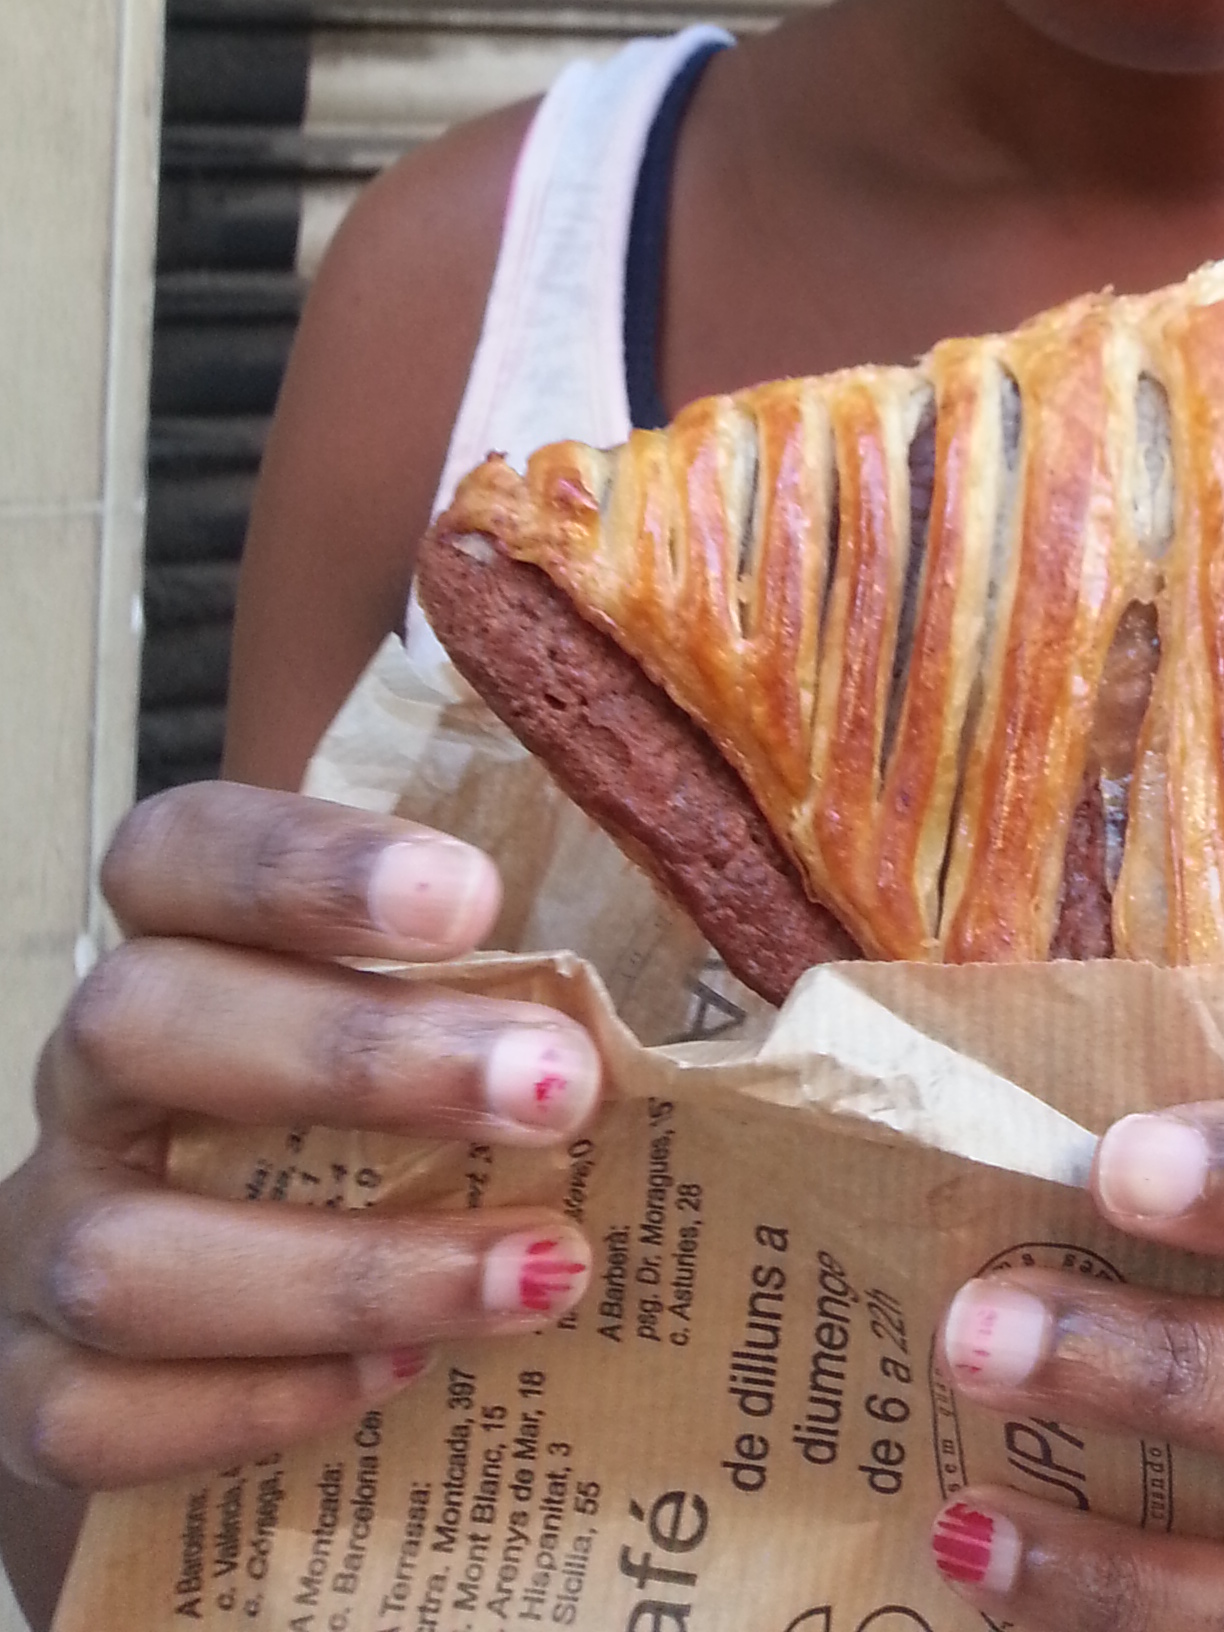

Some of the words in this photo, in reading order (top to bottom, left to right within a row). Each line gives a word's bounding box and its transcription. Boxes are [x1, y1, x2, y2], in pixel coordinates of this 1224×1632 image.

[640, 1130, 675, 1246] Moragues,
[675, 1184, 702, 1212] 28
[754, 1224, 788, 1252] a
[636, 1255, 662, 1285] Dr.
[667, 1221, 704, 1320] Asturies,
[597, 1325, 623, 1342] A
[636, 1294, 663, 1341] psg.
[669, 1328, 689, 1346] c.
[728, 1265, 786, 1417] dilluns
[864, 1288, 908, 1355] 22h
[517, 1370, 547, 1398] 18
[792, 1249, 859, 1465] diumenge
[879, 1357, 912, 1384] a
[448, 1367, 476, 1410] 397
[865, 1395, 909, 1423] 6
[480, 1405, 508, 1432] 15
[511, 1410, 547, 1460] Mar,
[431, 1418, 475, 1553] Montcada,
[470, 1443, 507, 1524] Blanc,
[508, 1468, 535, 1502] de
[720, 1434, 769, 1492] de
[858, 1439, 905, 1495] de
[331, 1456, 379, 1594] Barcelona
[573, 1481, 600, 1516] 55
[293, 1462, 343, 1606] Montcada:
[379, 1482, 431, 1617] Terrassa:
[518, 1466, 573, 1622] Hispanitat,
[548, 1442, 573, 1457] 3
[452, 1534, 493, 1612] Mont
[486, 1511, 531, 1619] Arenys
[552, 1528, 598, 1625] Sicilia,
[174, 1598, 203, 1618] A
